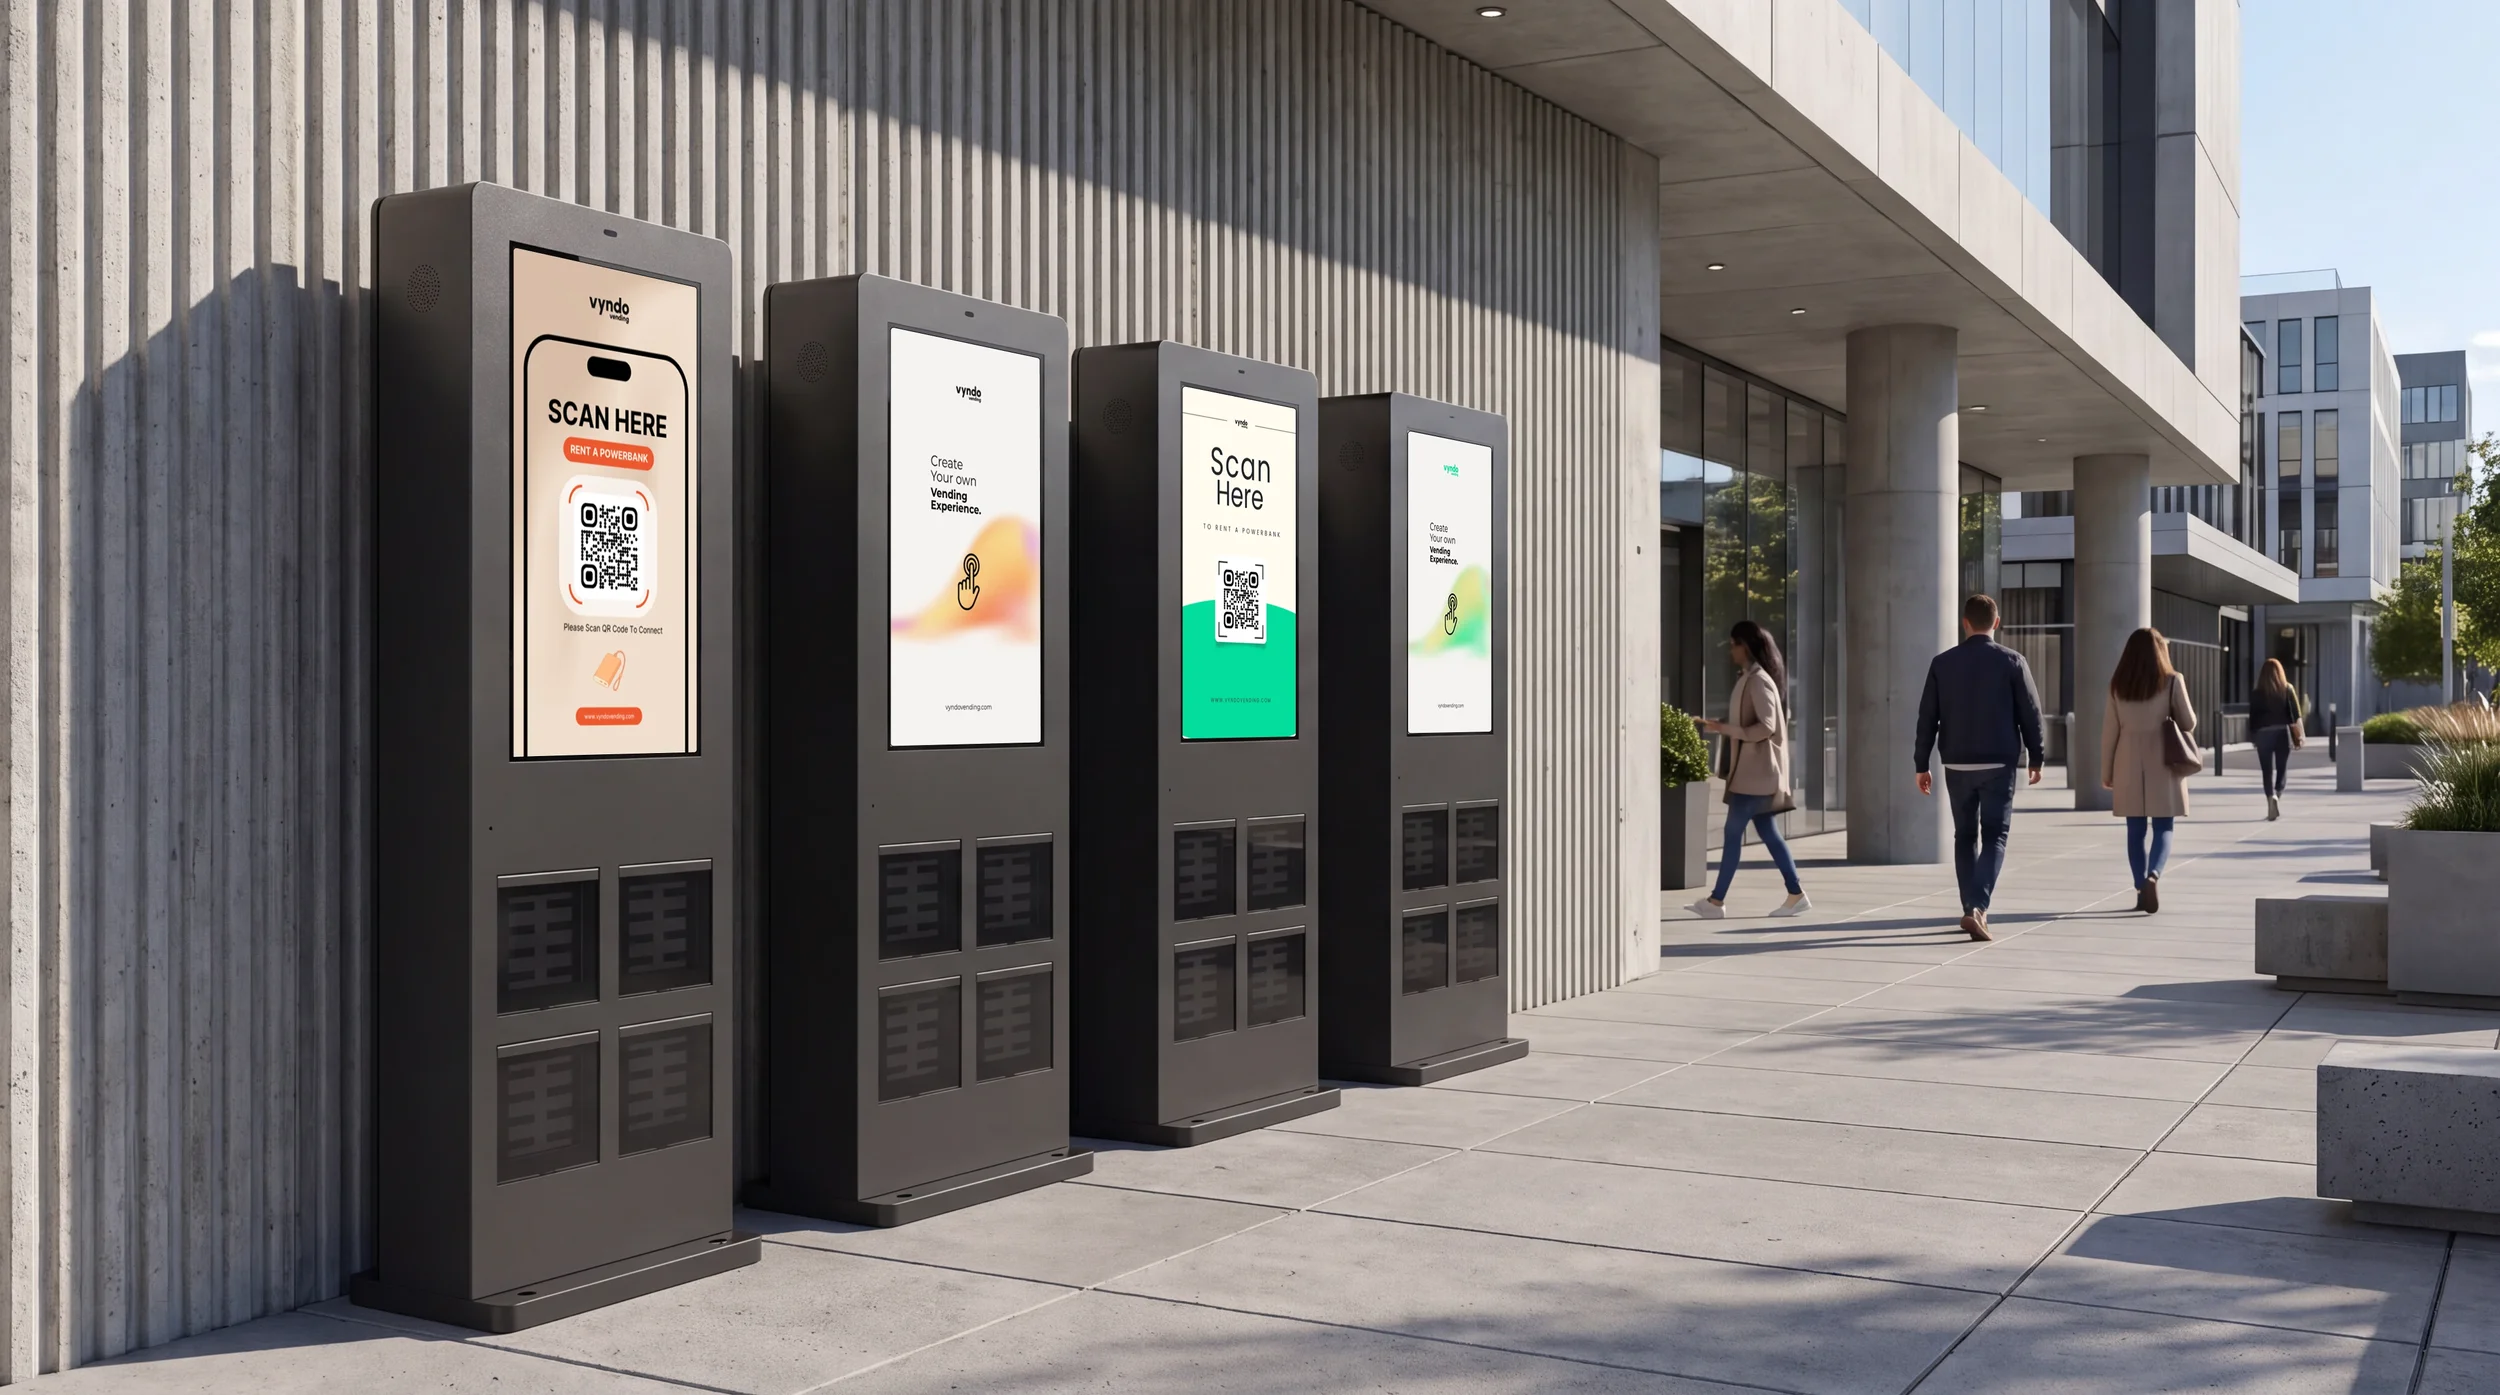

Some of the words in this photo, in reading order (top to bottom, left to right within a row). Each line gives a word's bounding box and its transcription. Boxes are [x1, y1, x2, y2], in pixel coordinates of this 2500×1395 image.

[589, 296, 630, 316] vyndo
[609, 313, 630, 324] vending
[955, 385, 982, 398] vyndo
[548, 398, 609, 430] SCAN
[615, 408, 667, 438] HERE
[570, 444, 591, 456] RENT
[592, 447, 599, 457] A
[599, 448, 648, 464] POWERBANK
[930, 455, 964, 470] Create
[1211, 446, 1270, 483] Scan
[930, 470, 953, 484] Your
[956, 475, 977, 487] own
[930, 487, 968, 503] Vending
[1217, 479, 1263, 510] Here
[930, 500, 982, 515] Experience.
[1215, 524, 1231, 532] RENT
[1242, 527, 1281, 538] POWERBANK
[1429, 522, 1448, 533] Create
[1429, 533, 1443, 544] Your
[1443, 536, 1456, 545] own
[1429, 546, 1451, 557] Vending
[1429, 555, 1459, 566] Experience.
[563, 623, 585, 633] Please
[586, 624, 600, 633] Scan
[601, 624, 611, 633] QR
[612, 625, 629, 634] Code
[630, 625, 637, 634] To
[638, 626, 663, 635] Connect
